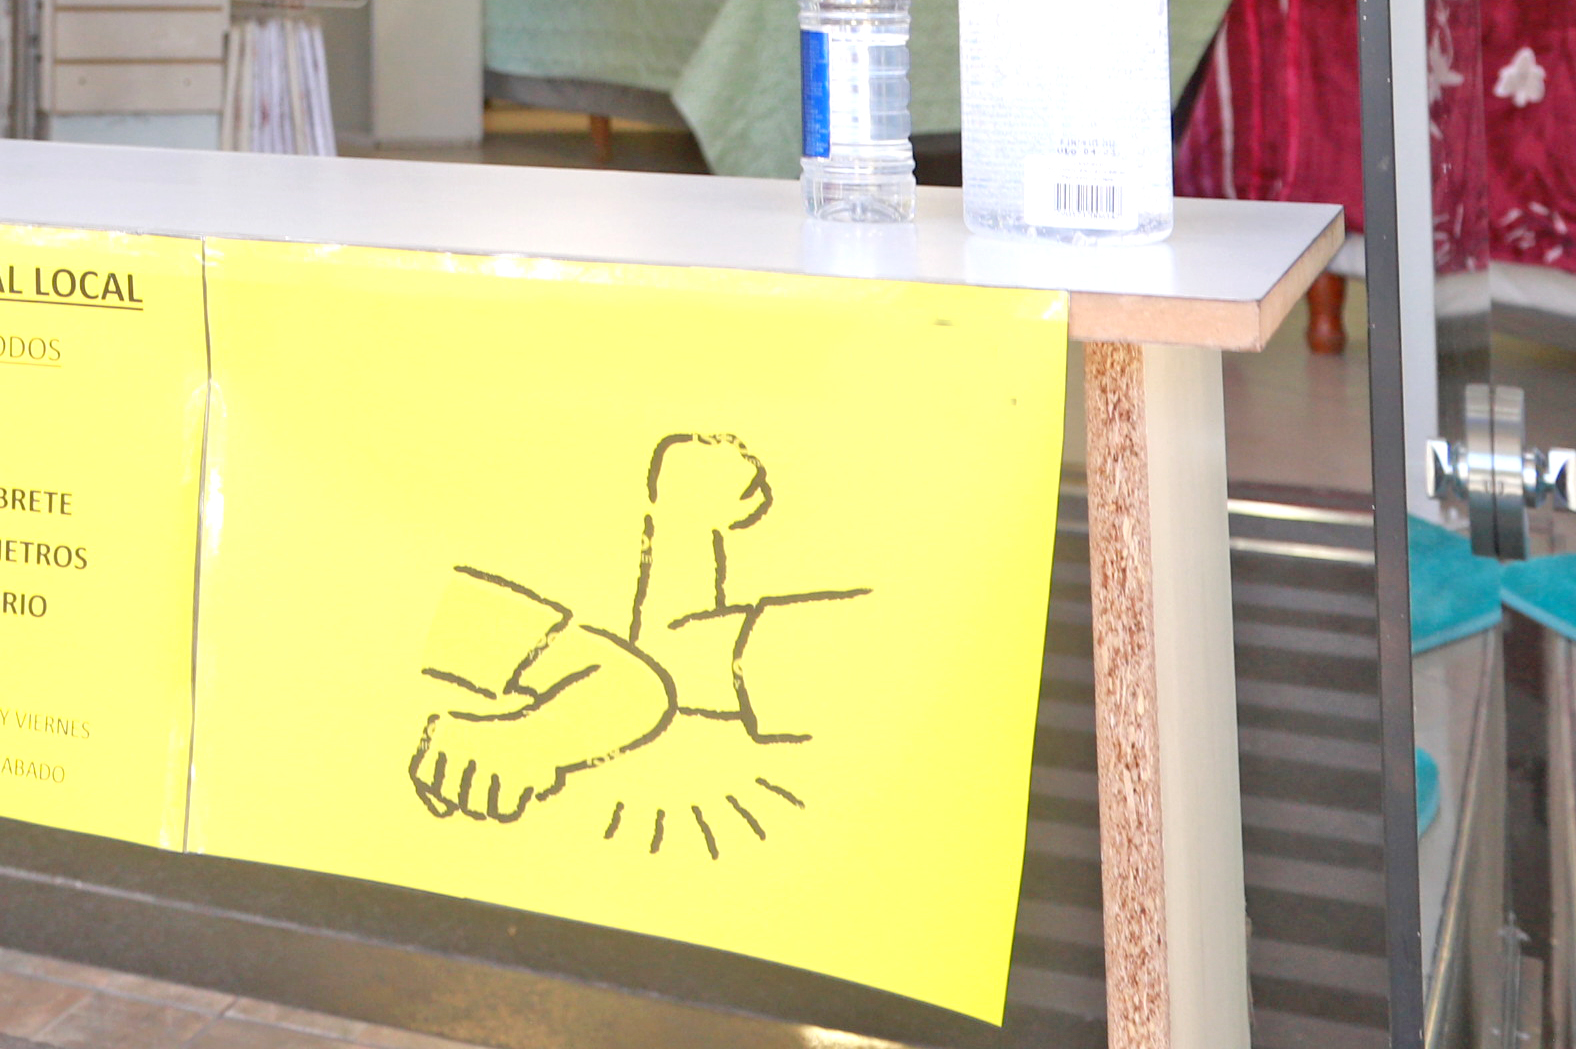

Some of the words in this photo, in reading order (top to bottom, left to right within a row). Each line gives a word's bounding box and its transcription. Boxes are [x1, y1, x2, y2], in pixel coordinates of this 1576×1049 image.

[34, 267, 143, 304] LOCAL
[0, 708, 12, 726] Y
[14, 710, 92, 740] VIERNES
